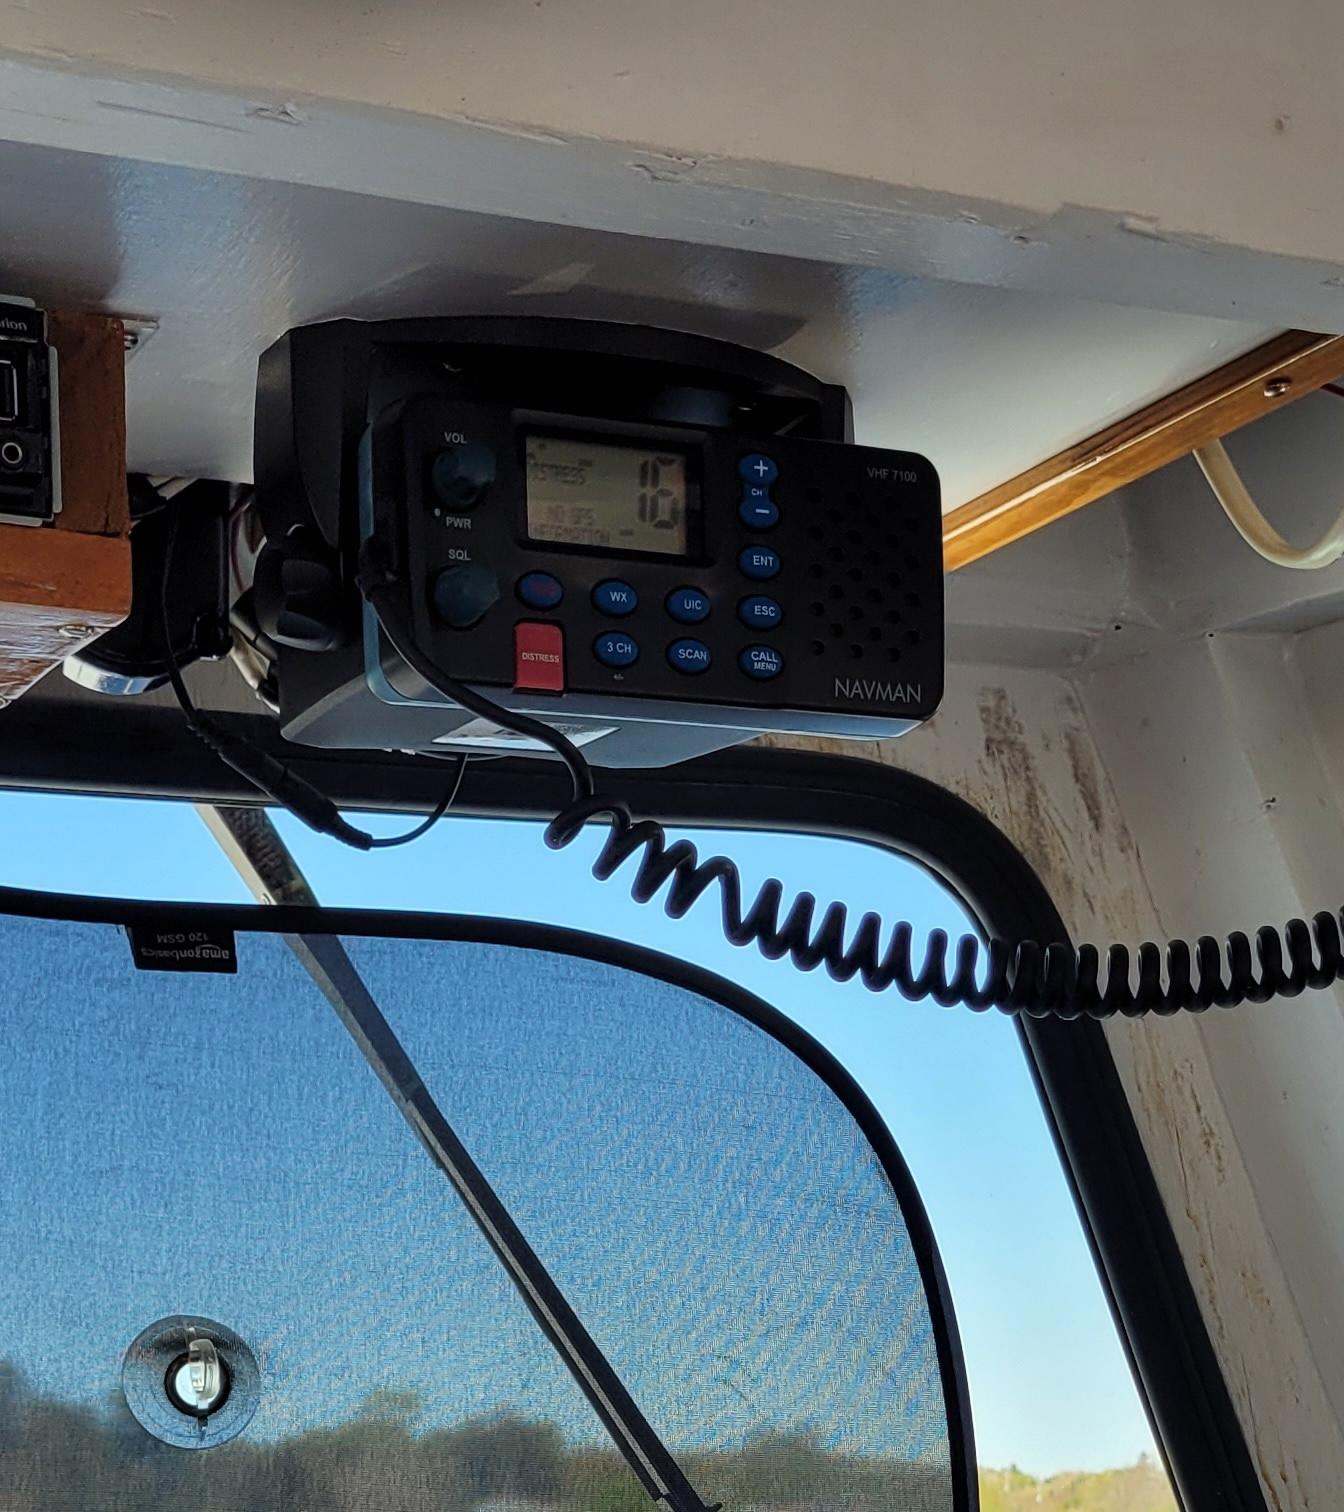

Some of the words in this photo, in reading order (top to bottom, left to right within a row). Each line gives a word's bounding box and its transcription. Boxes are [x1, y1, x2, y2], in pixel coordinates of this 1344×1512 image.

[444, 432, 468, 445] VOL
[866, 466, 888, 481] VHF
[892, 469, 918, 484] 7100
[751, 488, 764, 497] CH
[445, 515, 472, 530] PWR
[448, 548, 472, 562] SQL
[753, 555, 774, 568] ENT
[609, 591, 628, 603] WX
[684, 599, 703, 611] UIC
[754, 605, 776, 617] ESC
[607, 642, 614, 653] 3
[616, 643, 632, 655] CH
[522, 652, 560, 664] DISTRESS
[678, 649, 707, 661] SCAN
[751, 651, 779, 662] CALL
[753, 662, 777, 672] MENU
[834, 677, 922, 704] NAVMAN
[157, 933, 186, 944] GSM
[189, 932, 209, 942] 120
